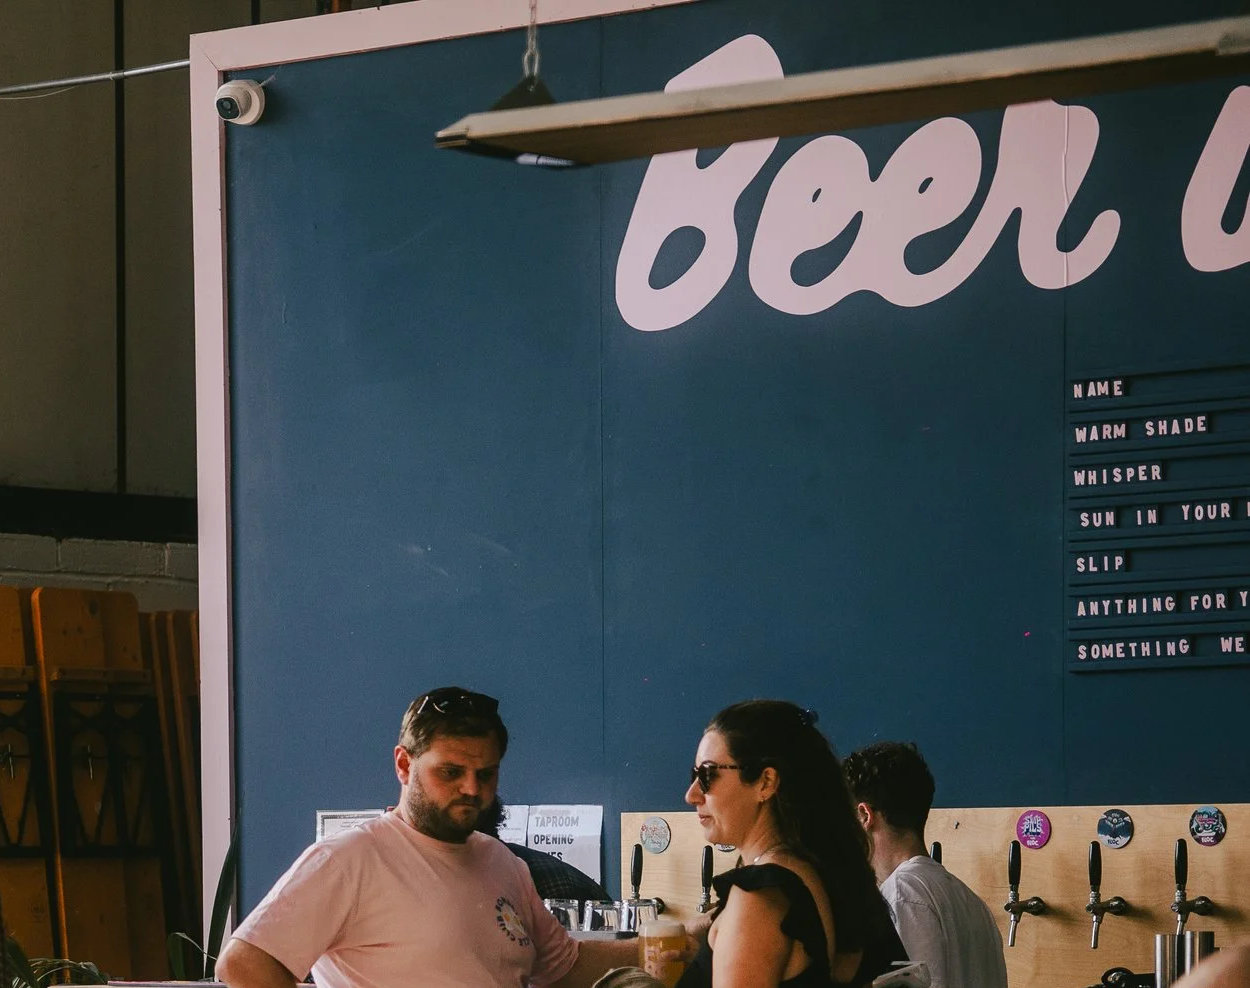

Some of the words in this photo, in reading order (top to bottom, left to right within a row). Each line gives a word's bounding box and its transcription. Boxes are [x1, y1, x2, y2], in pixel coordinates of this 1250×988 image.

[615, 34, 1121, 332] Beer
[1073, 380, 1123, 399] NAME
[1075, 423, 1126, 443] WARM
[1145, 415, 1207, 436] SHADE
[1073, 464, 1162, 486] WHISPER
[1080, 511, 1115, 527] SUN
[1136, 509, 1157, 526] IN
[1181, 502, 1231, 521] YOUR
[1076, 555, 1123, 573] SLIP
[1077, 596, 1176, 617] ANYTHING
[1190, 593, 1226, 611] FOR
[1077, 638, 1190, 660] SOMETHING
[1220, 636, 1245, 653] WE
[535, 816, 579, 827] TAPROOM
[533, 834, 574, 845] OPENING
